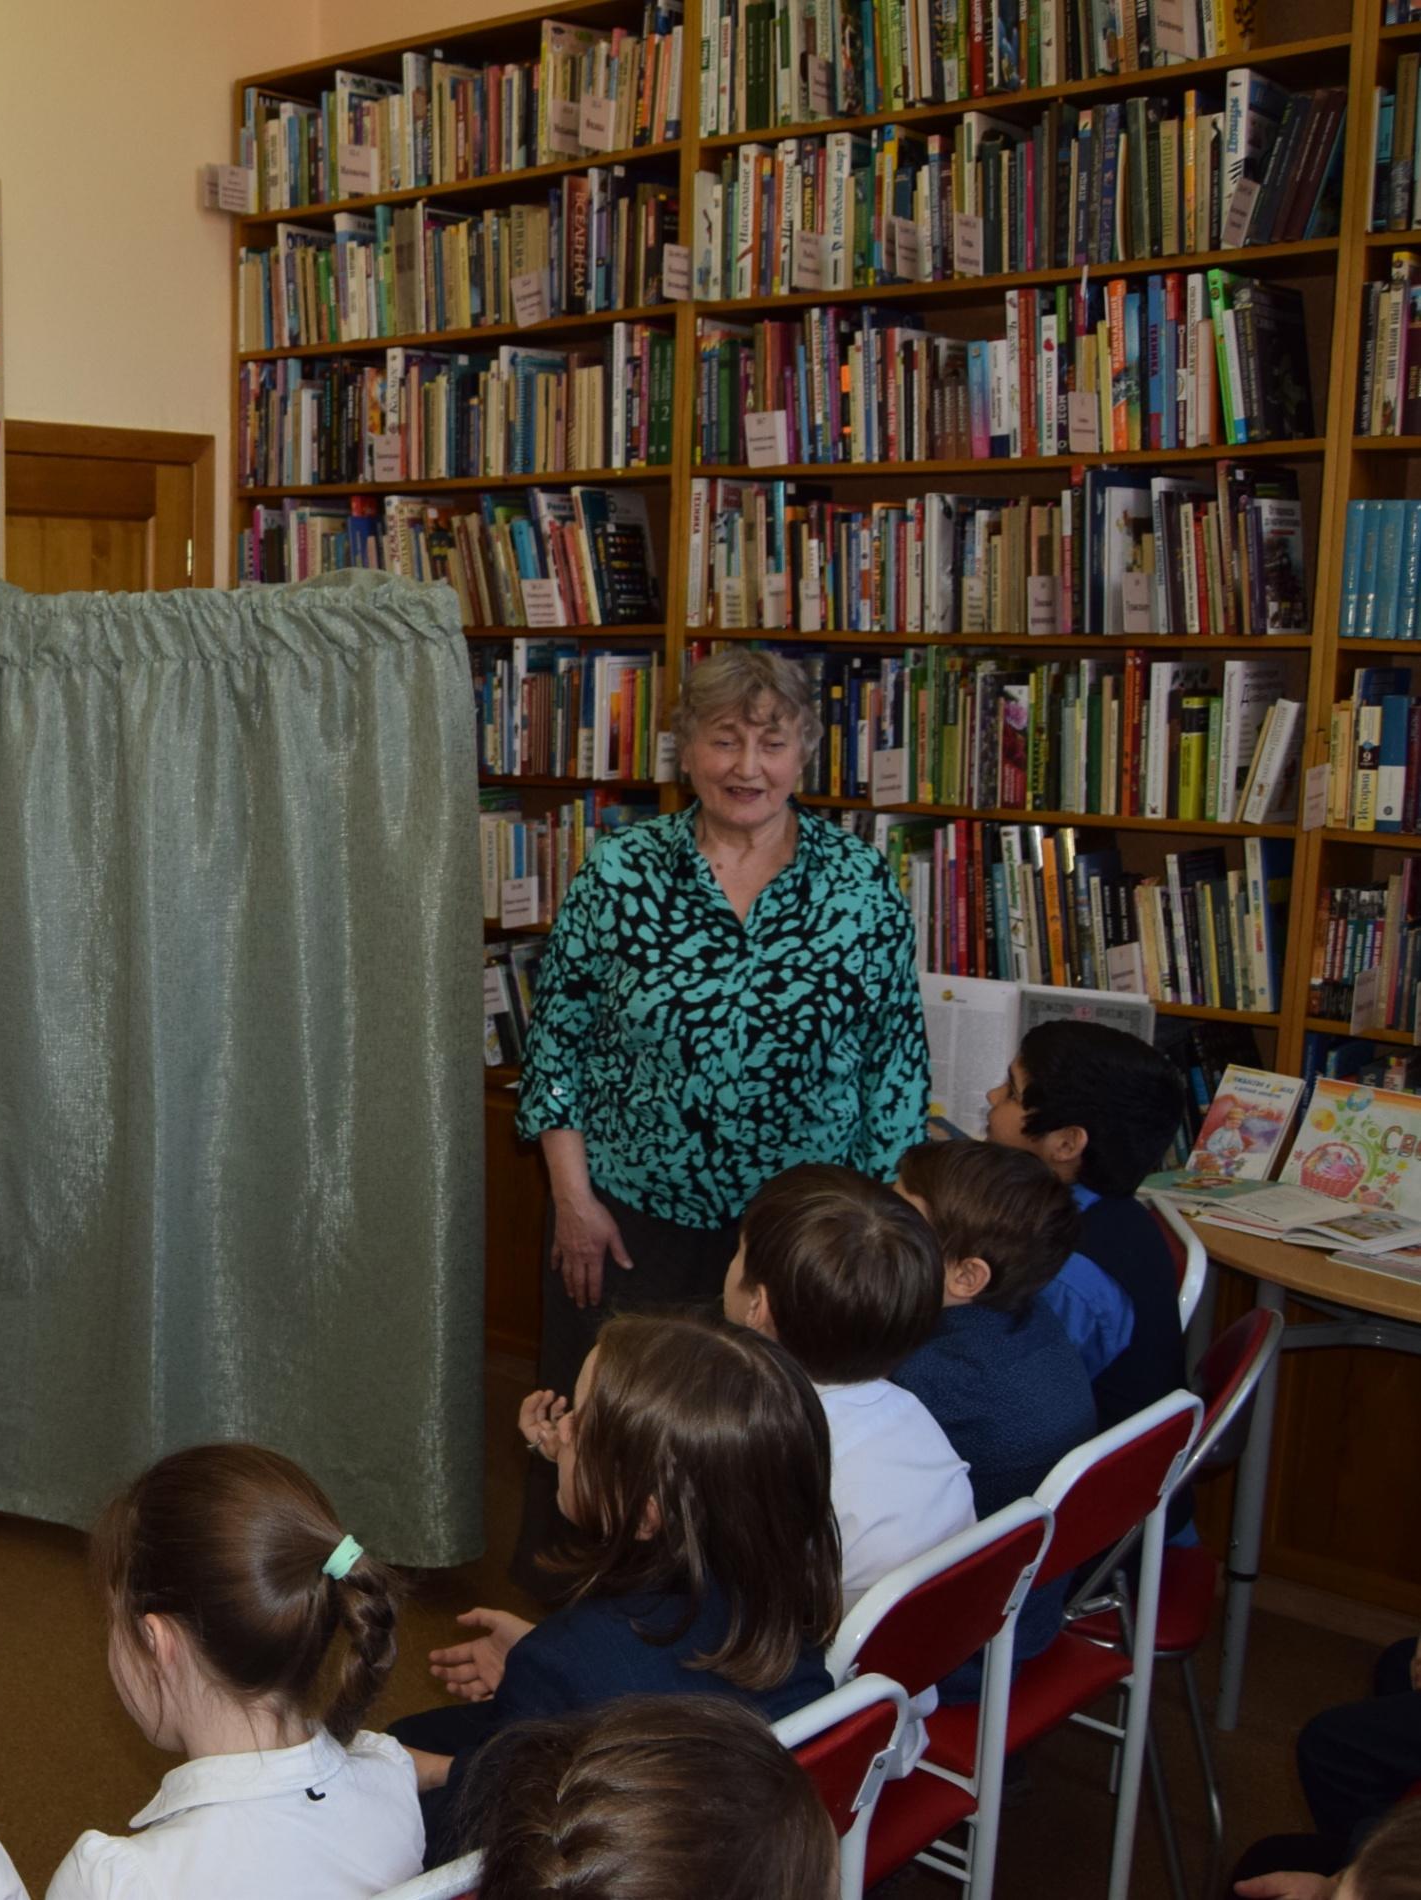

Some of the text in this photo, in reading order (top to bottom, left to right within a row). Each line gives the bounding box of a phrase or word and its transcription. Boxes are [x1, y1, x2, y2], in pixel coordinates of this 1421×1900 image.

[738, 168, 751, 244] Насекомые
[780, 163, 793, 239] Насекомые
[832, 149, 847, 237] Подводный мир
[573, 191, 589, 298] ВСЕЛЕННАЯ
[1149, 323, 1160, 378] ТЕХНИКА
[1043, 356, 1055, 441] КАК РАБОТАЕТ ТЕЛО
[1056, 394, 1068, 427] МОЗГ
[691, 491, 702, 536] ТЕХНИКА
[1357, 772, 1371, 820] История
